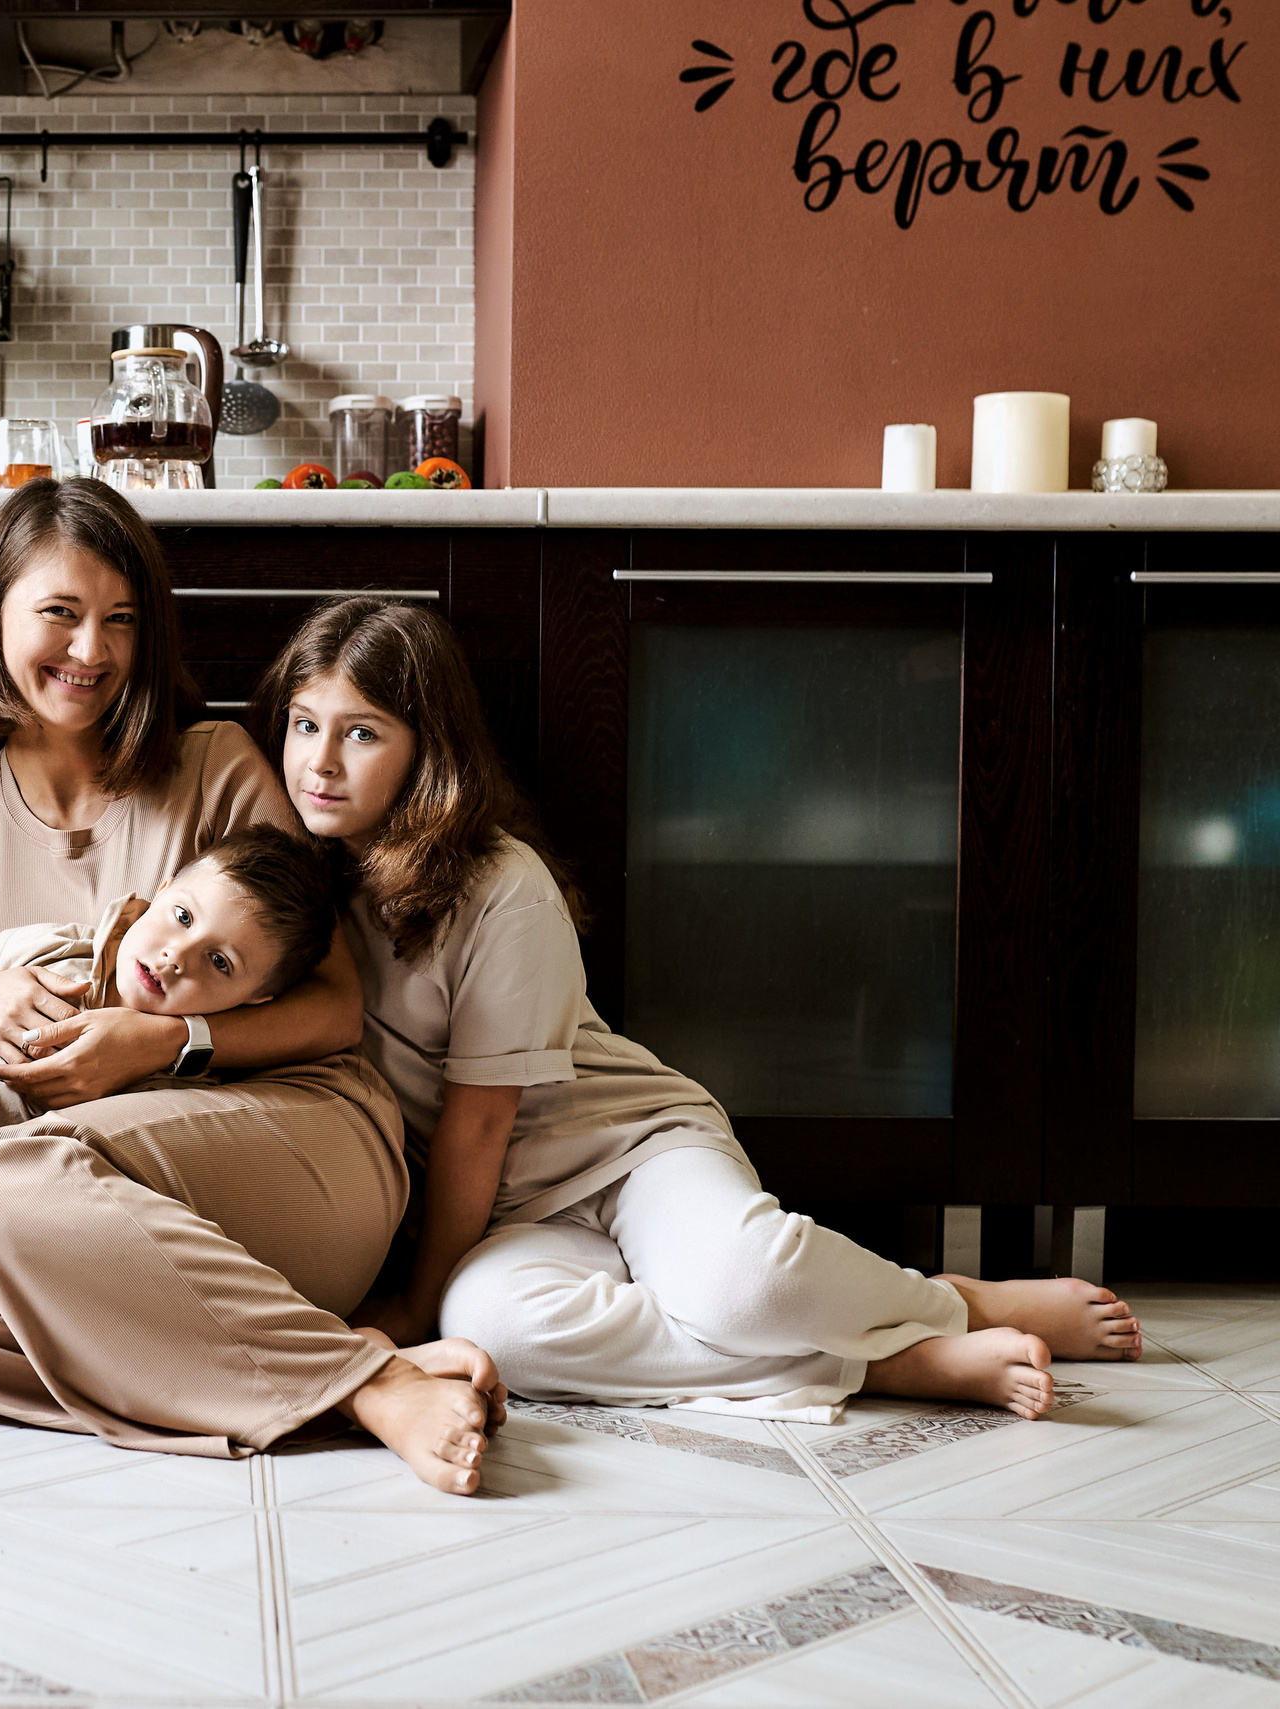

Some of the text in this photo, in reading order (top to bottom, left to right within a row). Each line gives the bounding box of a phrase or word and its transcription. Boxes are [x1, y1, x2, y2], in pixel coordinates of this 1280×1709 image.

[771, 0, 1249, 124] где в них
[791, 100, 1141, 230] верят
